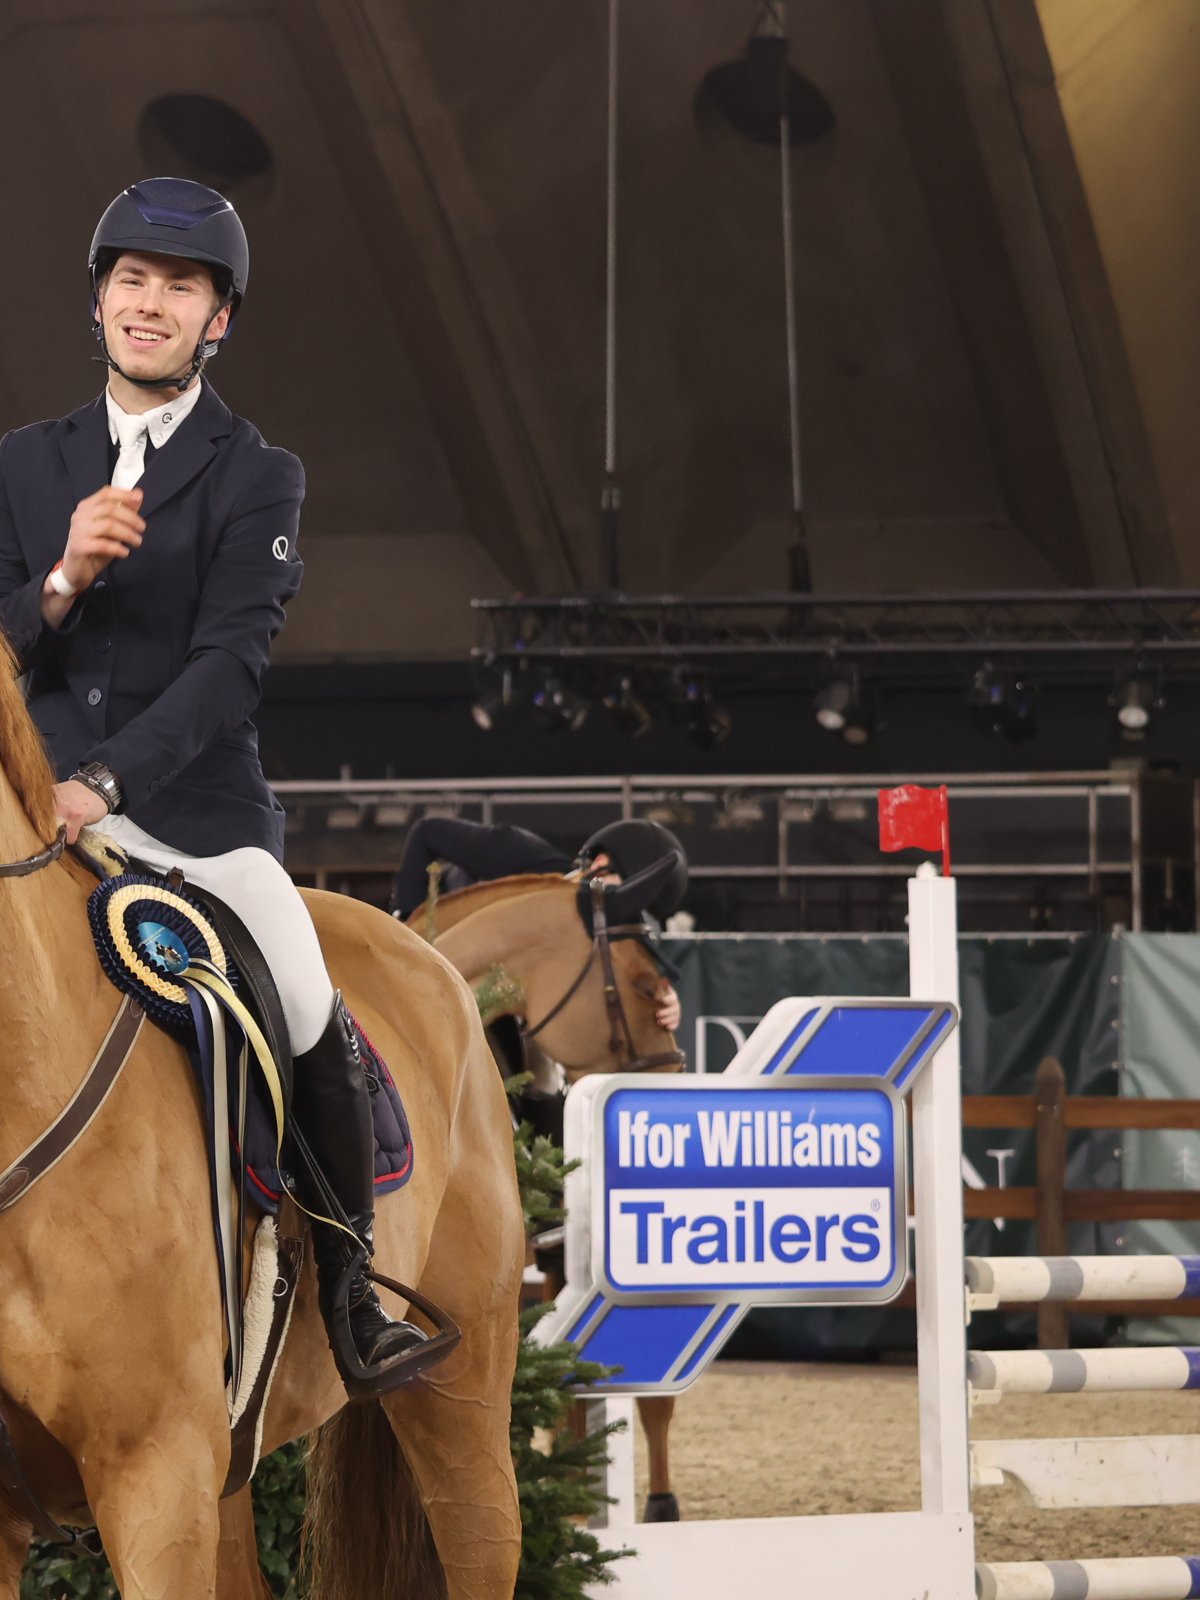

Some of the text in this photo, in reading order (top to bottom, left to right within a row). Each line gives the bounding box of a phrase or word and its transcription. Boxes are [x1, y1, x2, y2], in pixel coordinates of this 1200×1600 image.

[618, 1110, 881, 1168] Ifor Williams
[619, 1200, 881, 1265] Trailers
